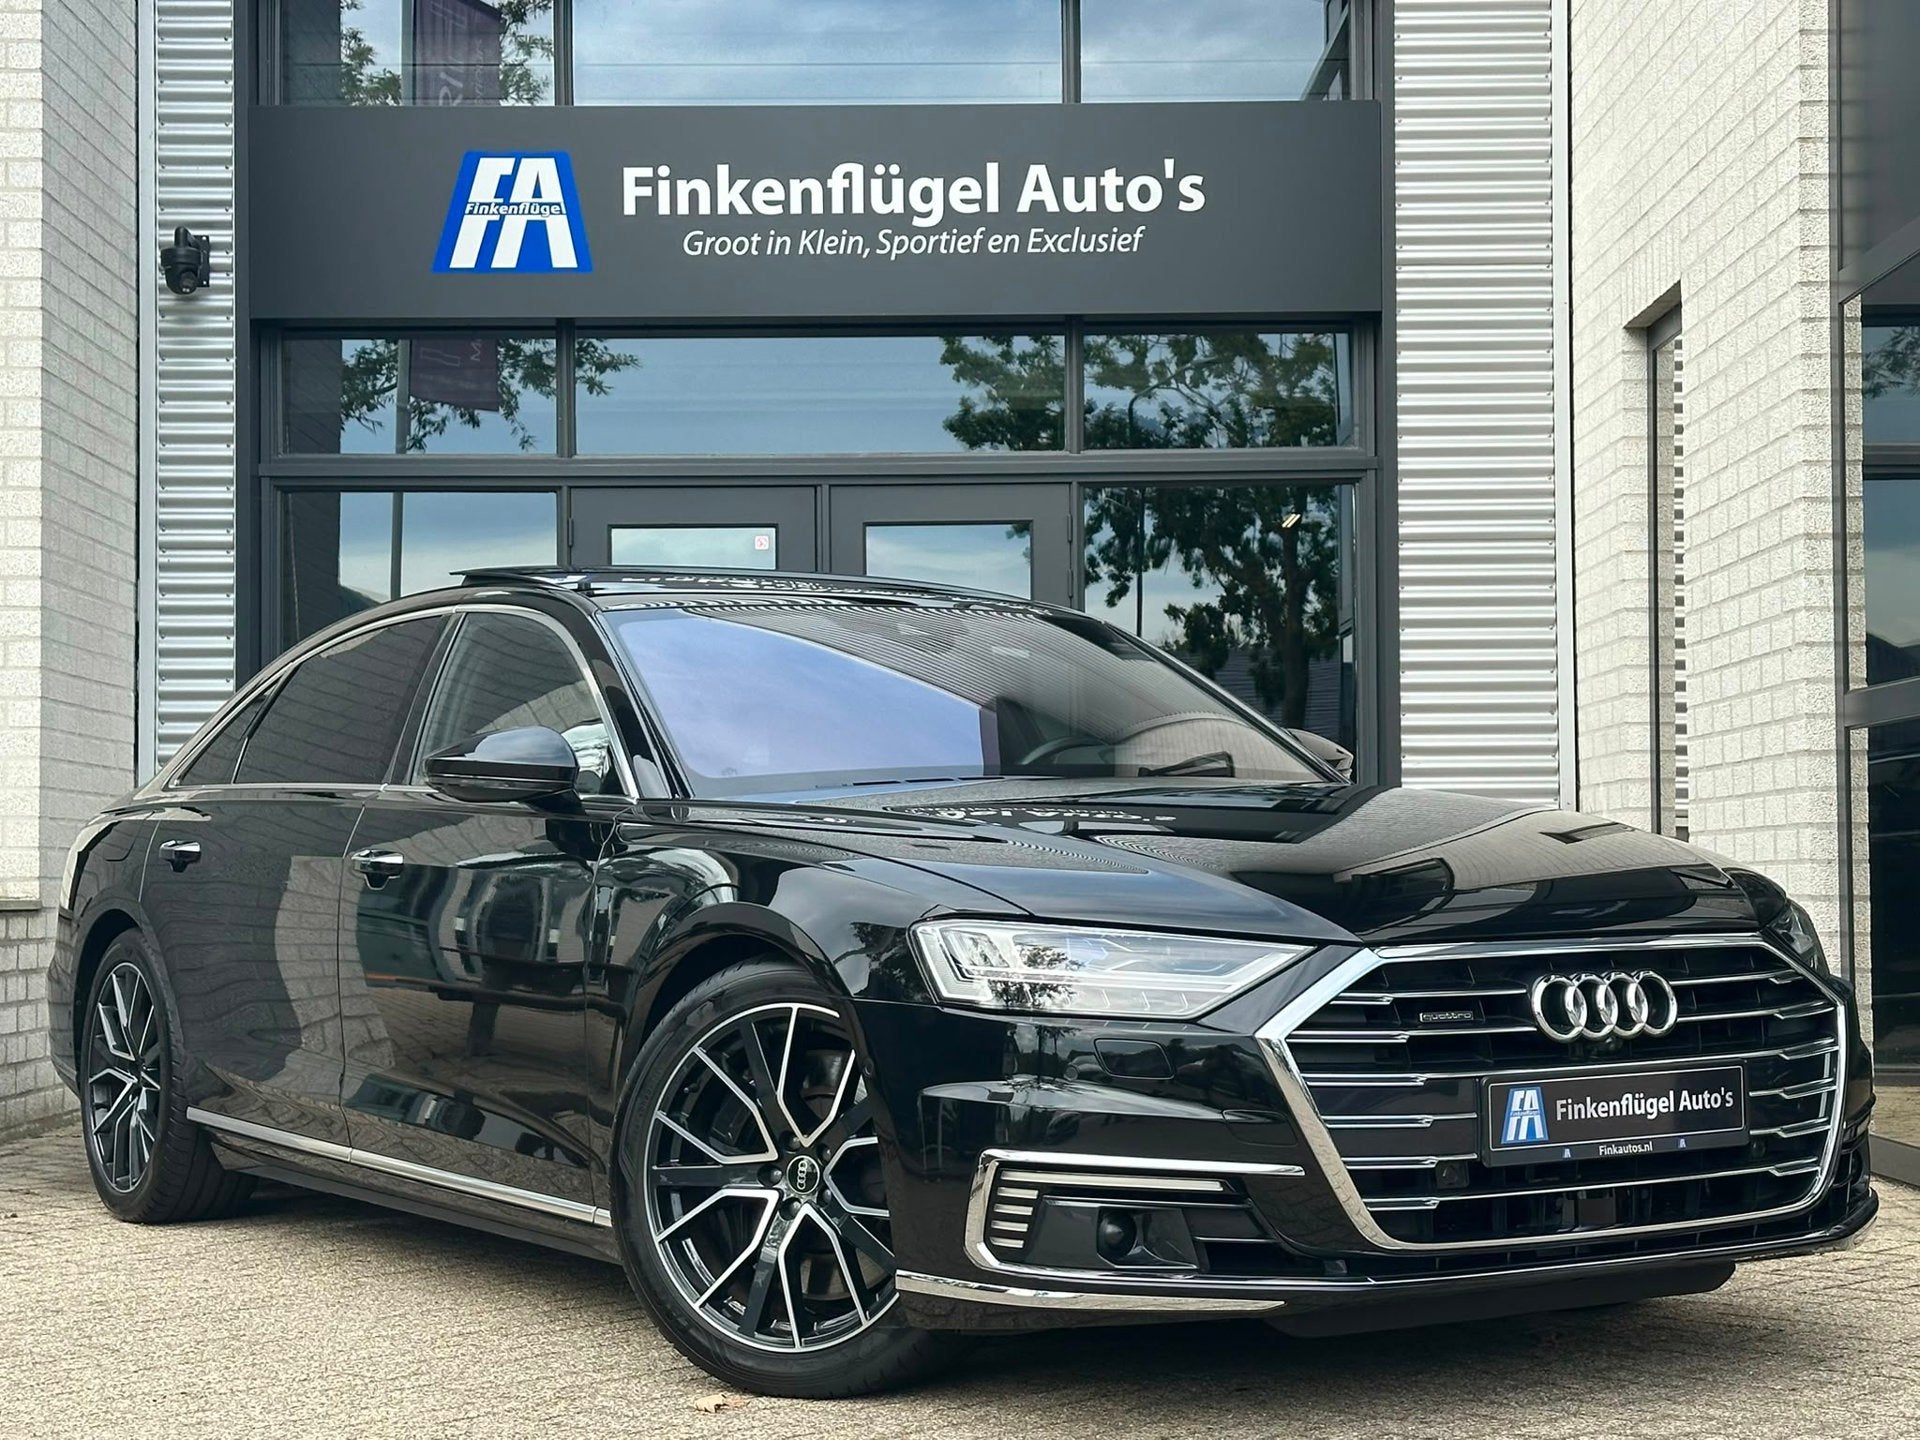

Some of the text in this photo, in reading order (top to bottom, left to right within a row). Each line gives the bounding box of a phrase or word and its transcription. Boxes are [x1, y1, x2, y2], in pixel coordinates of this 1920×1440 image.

[464, 202, 567, 218] Finkenflügel
[622, 158, 1207, 228] Finkenflügel Auto's
[682, 225, 1147, 261] Groot in Klein, Sportief en Exclusief
[1556, 1086, 1734, 1121] Finkenflügel Auto's
[1598, 1140, 1654, 1156] Finkautos.nl
